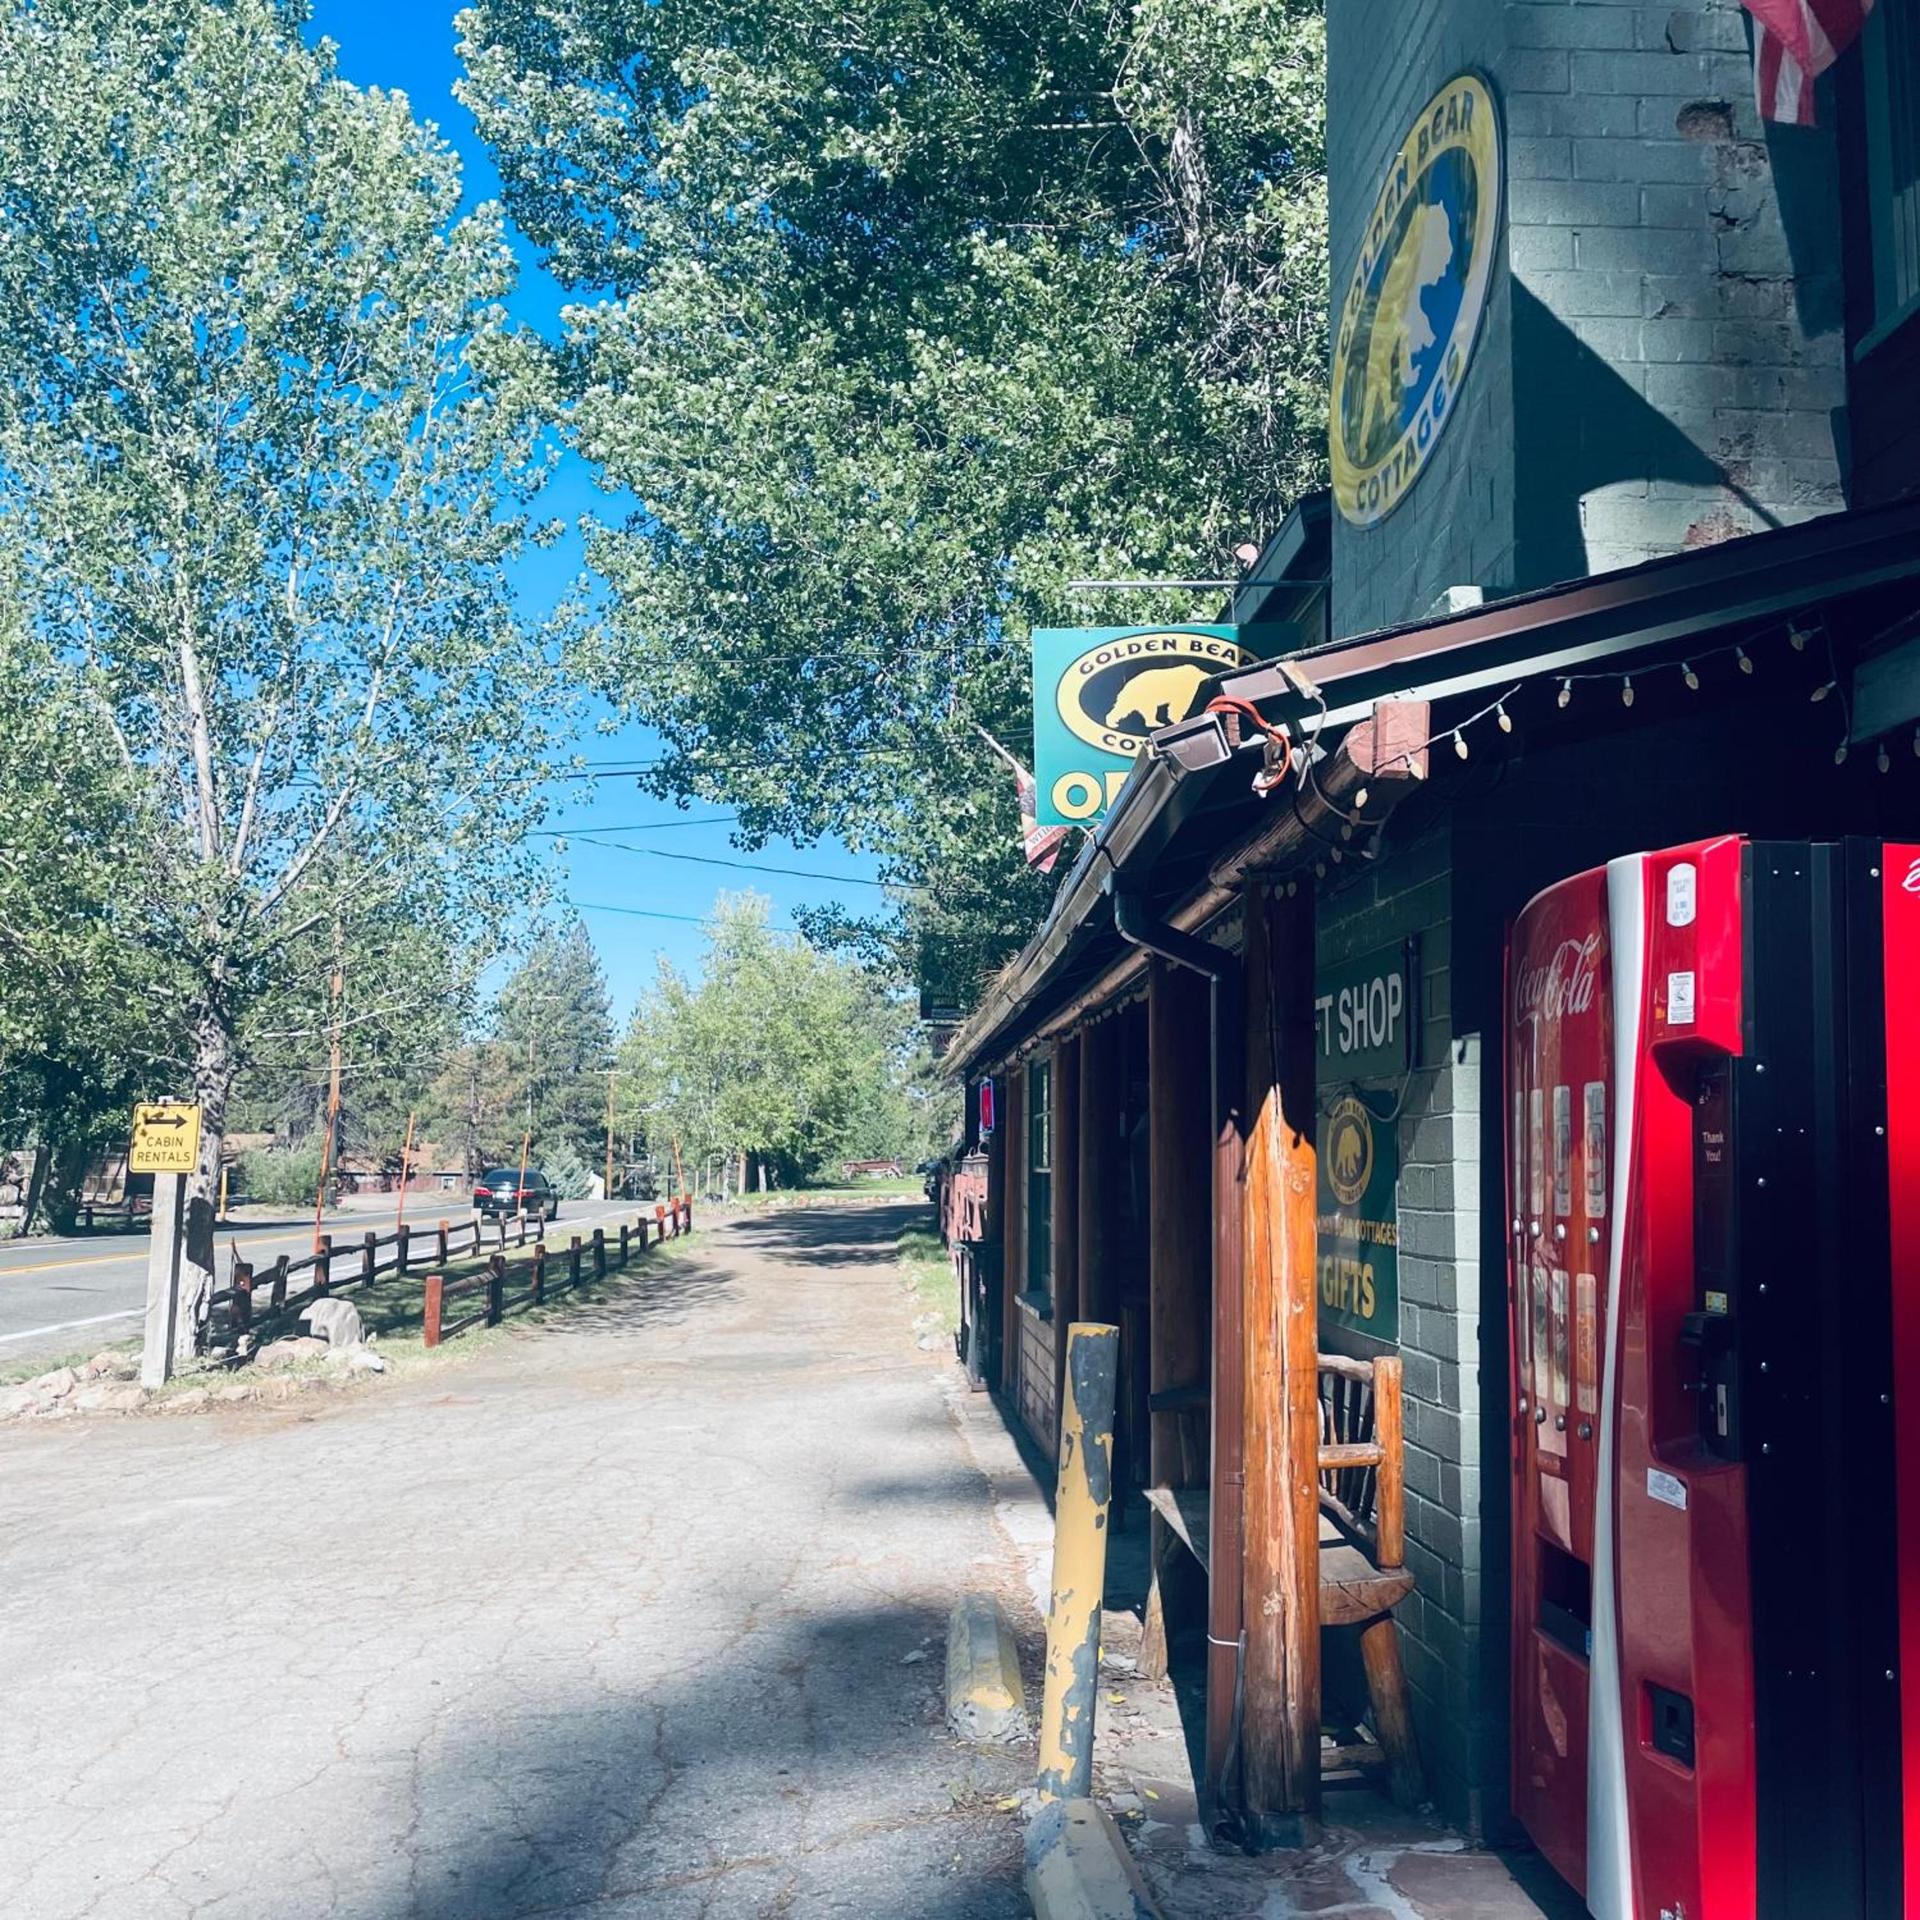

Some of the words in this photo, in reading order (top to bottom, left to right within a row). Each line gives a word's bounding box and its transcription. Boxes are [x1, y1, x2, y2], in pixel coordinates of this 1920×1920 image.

[1341, 154, 1409, 358] GOLDEN
[1417, 91, 1474, 164] BEAR
[1357, 343, 1459, 511] COTTAGES
[1080, 639, 1177, 675] GOLDEN
[1514, 933, 1602, 1027] Coca-Cola
[1314, 993, 1333, 1056] T
[1338, 972, 1403, 1054] SHOP
[146, 1136, 184, 1148] CABIN
[1702, 1130, 1724, 1144] Thank
[137, 1151, 191, 1163] RENTALS
[1705, 1149, 1721, 1162] You!
[1354, 1218, 1397, 1246] COTTAGES
[1323, 1255, 1375, 1319] GIFTS
